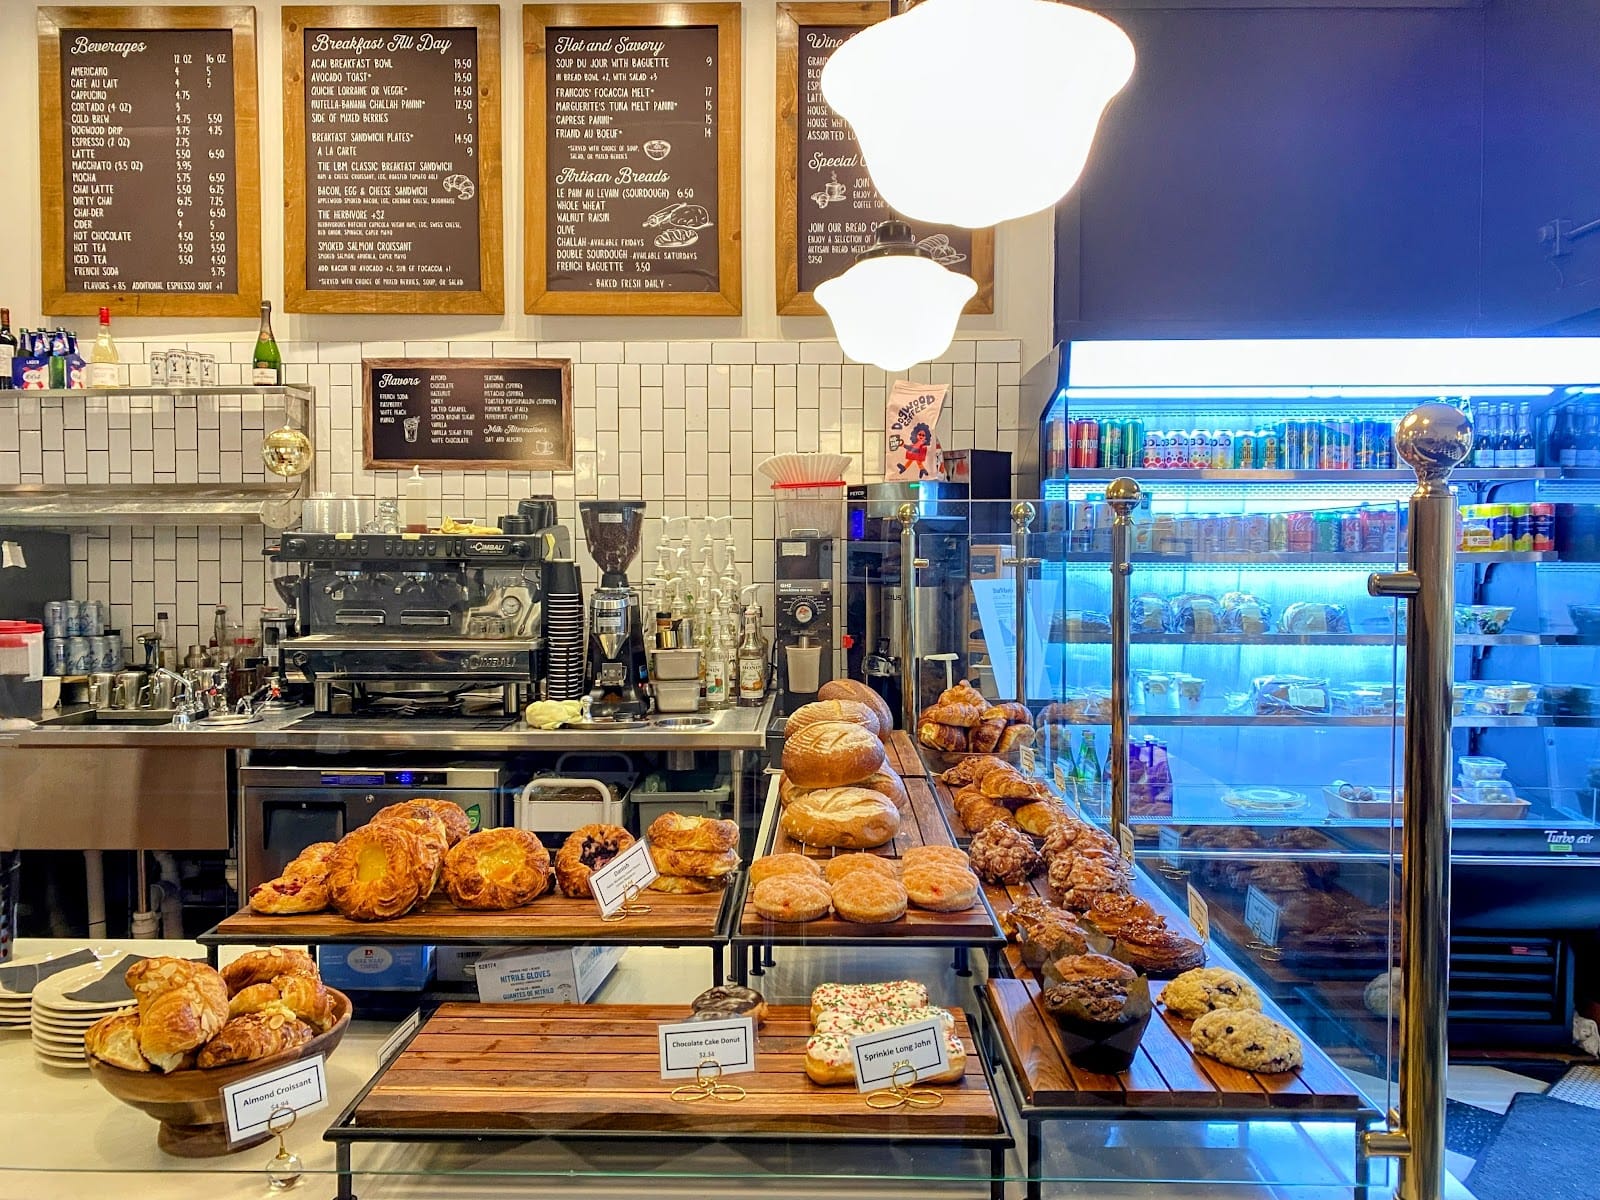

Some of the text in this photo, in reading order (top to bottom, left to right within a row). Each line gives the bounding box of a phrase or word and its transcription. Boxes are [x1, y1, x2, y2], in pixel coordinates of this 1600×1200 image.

[312, 34, 452, 54] Breakfast All Day
[807, 33, 843, 48] Wine
[71, 37, 147, 57] Beverages
[555, 37, 665, 56] Hot and Savory
[311, 59, 392, 68] ACAI BREAKFAST BOWL
[556, 58, 669, 68] SOUP DU JOUR WITH BAGUETTE
[71, 67, 108, 76] AMERICANO
[311, 73, 342, 82] AVOCADO
[311, 86, 367, 95] QUICHE LORRAINE
[595, 88, 628, 97] FOCACCIA
[71, 102, 104, 112] CORTADO
[370, 100, 398, 109] CHALLAH
[556, 101, 650, 111] MARGUERITE'S TUNA MELT
[808, 106, 827, 115] HOUSE
[72, 114, 109, 123] COLD BREW
[312, 113, 388, 122] SIDE MIXED BERRIES
[556, 115, 585, 124] CAPRESE
[807, 119, 828, 127] HOUSE
[72, 126, 123, 135] DOGWOOD DRIP
[556, 129, 593, 138] FRIAND AU
[312, 133, 383, 142] BREAKFAST SANDWICH
[808, 131, 844, 140] ASSORTED
[72, 137, 104, 147] ESPRESSO
[72, 149, 224, 159] LATTE 6.50
[337, 146, 356, 156] CARTE
[72, 161, 111, 170] MACCHIATO
[318, 162, 452, 171] THE LBM CLASSIC BREAKFAST SANDWICH
[809, 152, 857, 172] Special
[73, 173, 225, 182] MOCHA 6.50
[556, 167, 670, 184] Artisan Breads
[854, 178, 870, 188] JOIN
[73, 185, 114, 194] CHAI LATTE
[318, 186, 427, 196] BACON, EGG CHEESE SANDWICH
[568, 188, 693, 199] PAIN LEVAIN (SOURDOUGH) 6.50
[73, 196, 112, 205] DIRTY CHAI
[557, 201, 605, 210] WHOLE WHEAT
[74, 208, 225, 218] CHAI-DER 6.50
[318, 210, 367, 219] THE HERBIVORE
[557, 213, 609, 222] WALNUT RAISIN
[74, 220, 92, 229] CIDER
[808, 223, 867, 232] JOIN OUR BREAD
[557, 225, 575, 235] OLIVE
[74, 231, 131, 241] HOT CHOCOLATE
[808, 235, 862, 243] ENJOY SELECTION
[557, 237, 586, 246] CHALLAH
[74, 243, 106, 252] HOT TEA
[318, 242, 411, 251] SMOKED SALMON CROISSANT
[557, 249, 583, 259] DOUBLE
[587, 249, 627, 259] SOURDOUGH
[74, 255, 106, 264] ICED TEA
[557, 261, 623, 271] FRENCH BAGUETTE
[75, 267, 118, 275] FRENCH SODA
[596, 279, 664, 288] BAKED FRESH DAILY
[379, 374, 421, 388] Flavors
[904, 404, 926, 426] COFFEE
[475, 542, 504, 551] CIMBALI
[1544, 830, 1594, 844] Turbo air
[500, 973, 524, 983] NITRILE
[526, 970, 551, 980] GLOVES
[502, 990, 526, 1000] GUANTES
[534, 987, 554, 996] NITRILO
[672, 1036, 740, 1048] Chocolate Cake Donut
[864, 1039, 932, 1062] Sprinkle Long John
[243, 1078, 312, 1106] Almond Croissant
